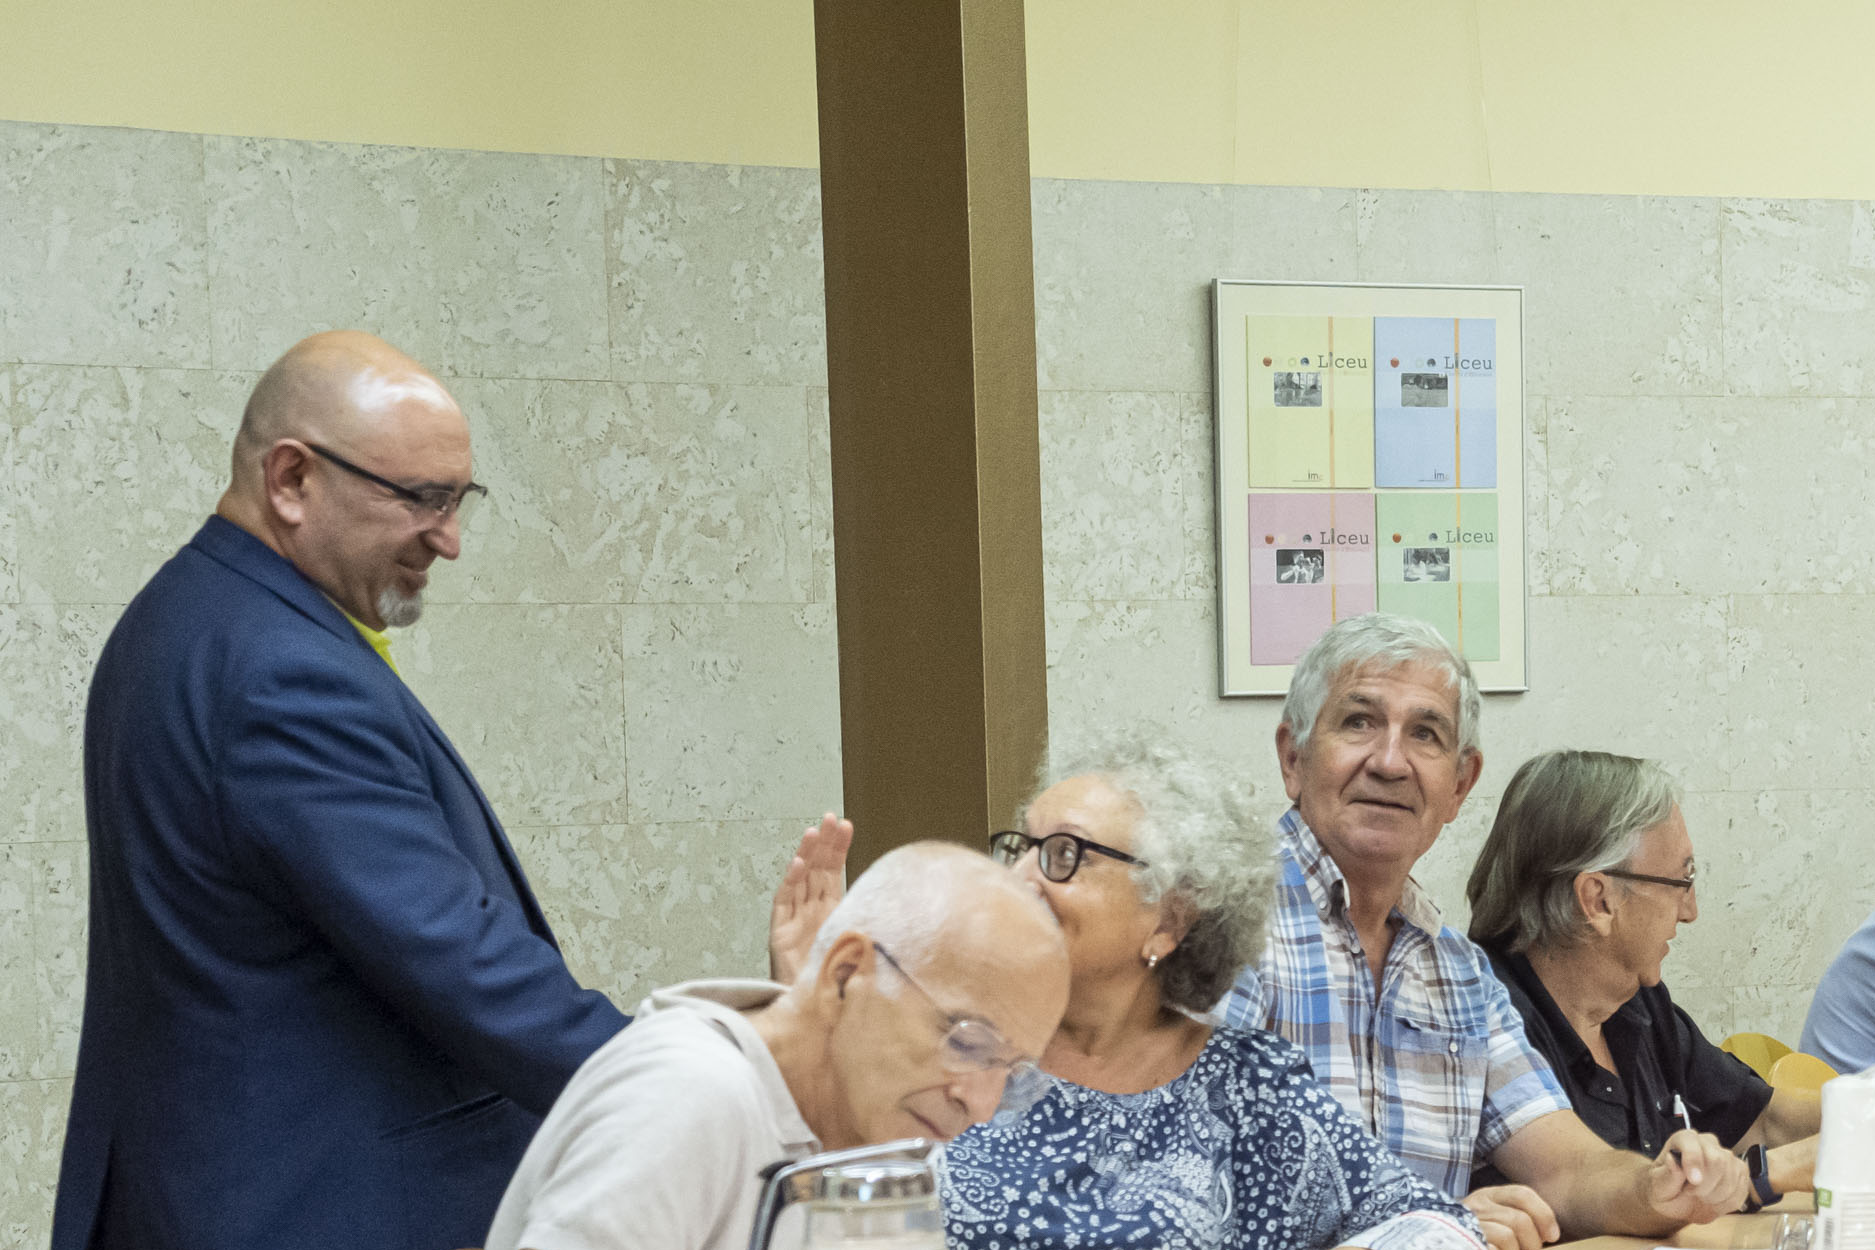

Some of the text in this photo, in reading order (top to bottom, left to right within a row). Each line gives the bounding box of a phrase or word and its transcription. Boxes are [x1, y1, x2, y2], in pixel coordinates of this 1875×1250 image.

[1317, 351, 1368, 369] Liceu
[1443, 352, 1493, 370] Liceu
[1319, 527, 1370, 545] Liceu
[1445, 526, 1495, 544] Liceu
